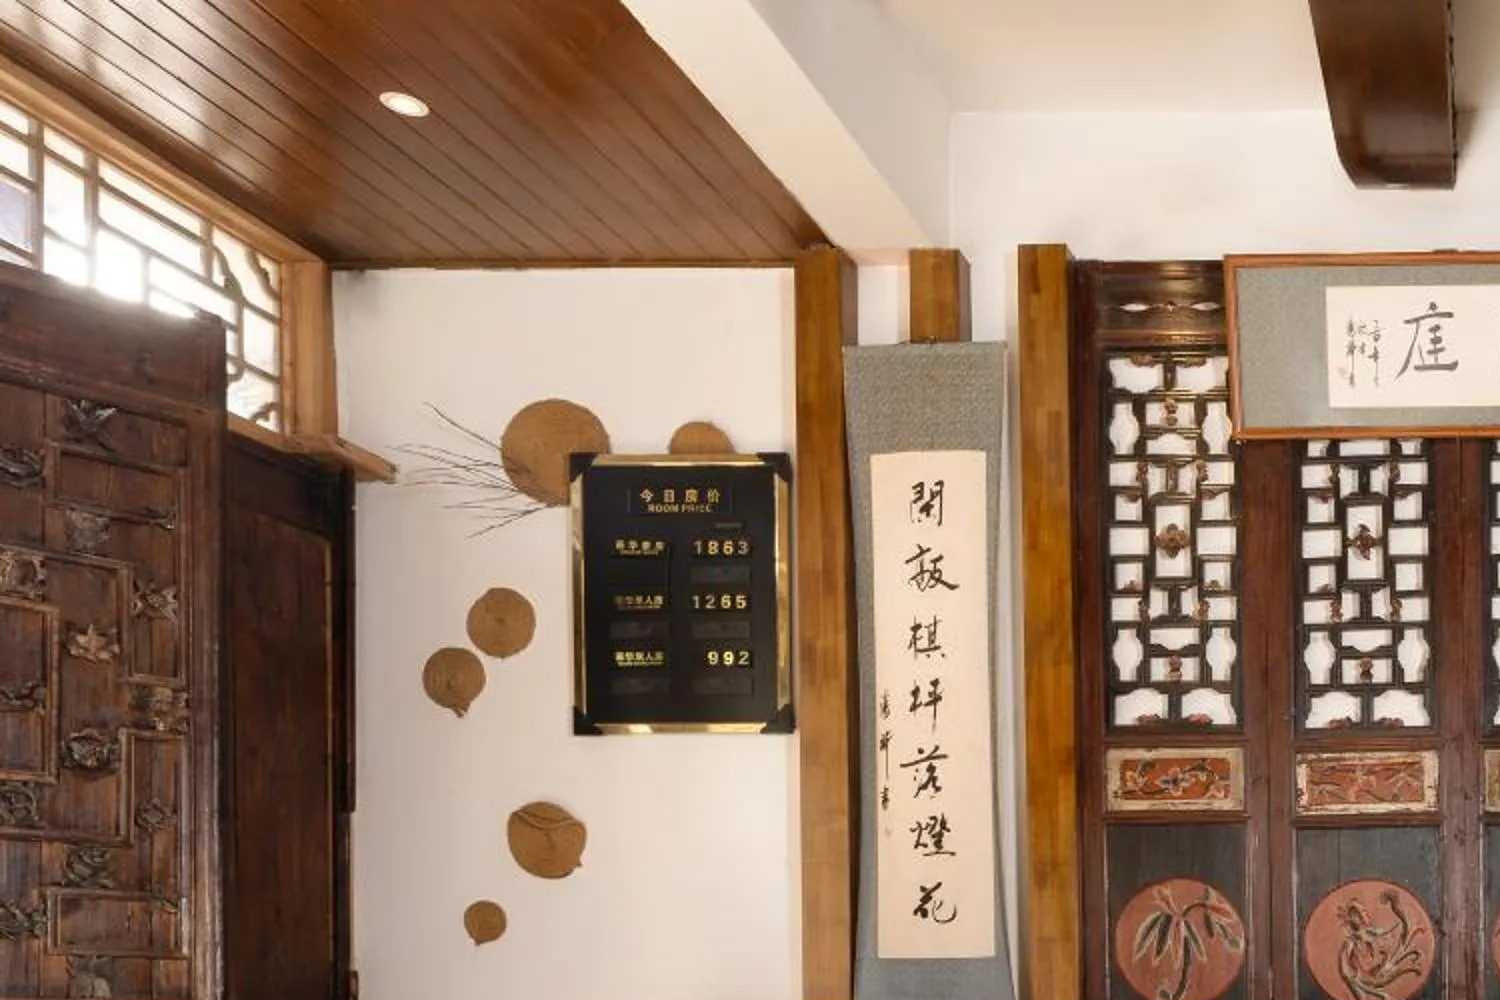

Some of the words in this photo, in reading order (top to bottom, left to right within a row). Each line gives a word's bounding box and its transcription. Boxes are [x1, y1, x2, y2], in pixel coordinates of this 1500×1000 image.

[639, 487, 721, 503] 今日房价
[647, 503, 679, 513] ROOM
[681, 503, 714, 513] PRICE
[693, 540, 750, 556] 1863
[691, 594, 748, 609] 1265
[706, 650, 750, 666] 992
